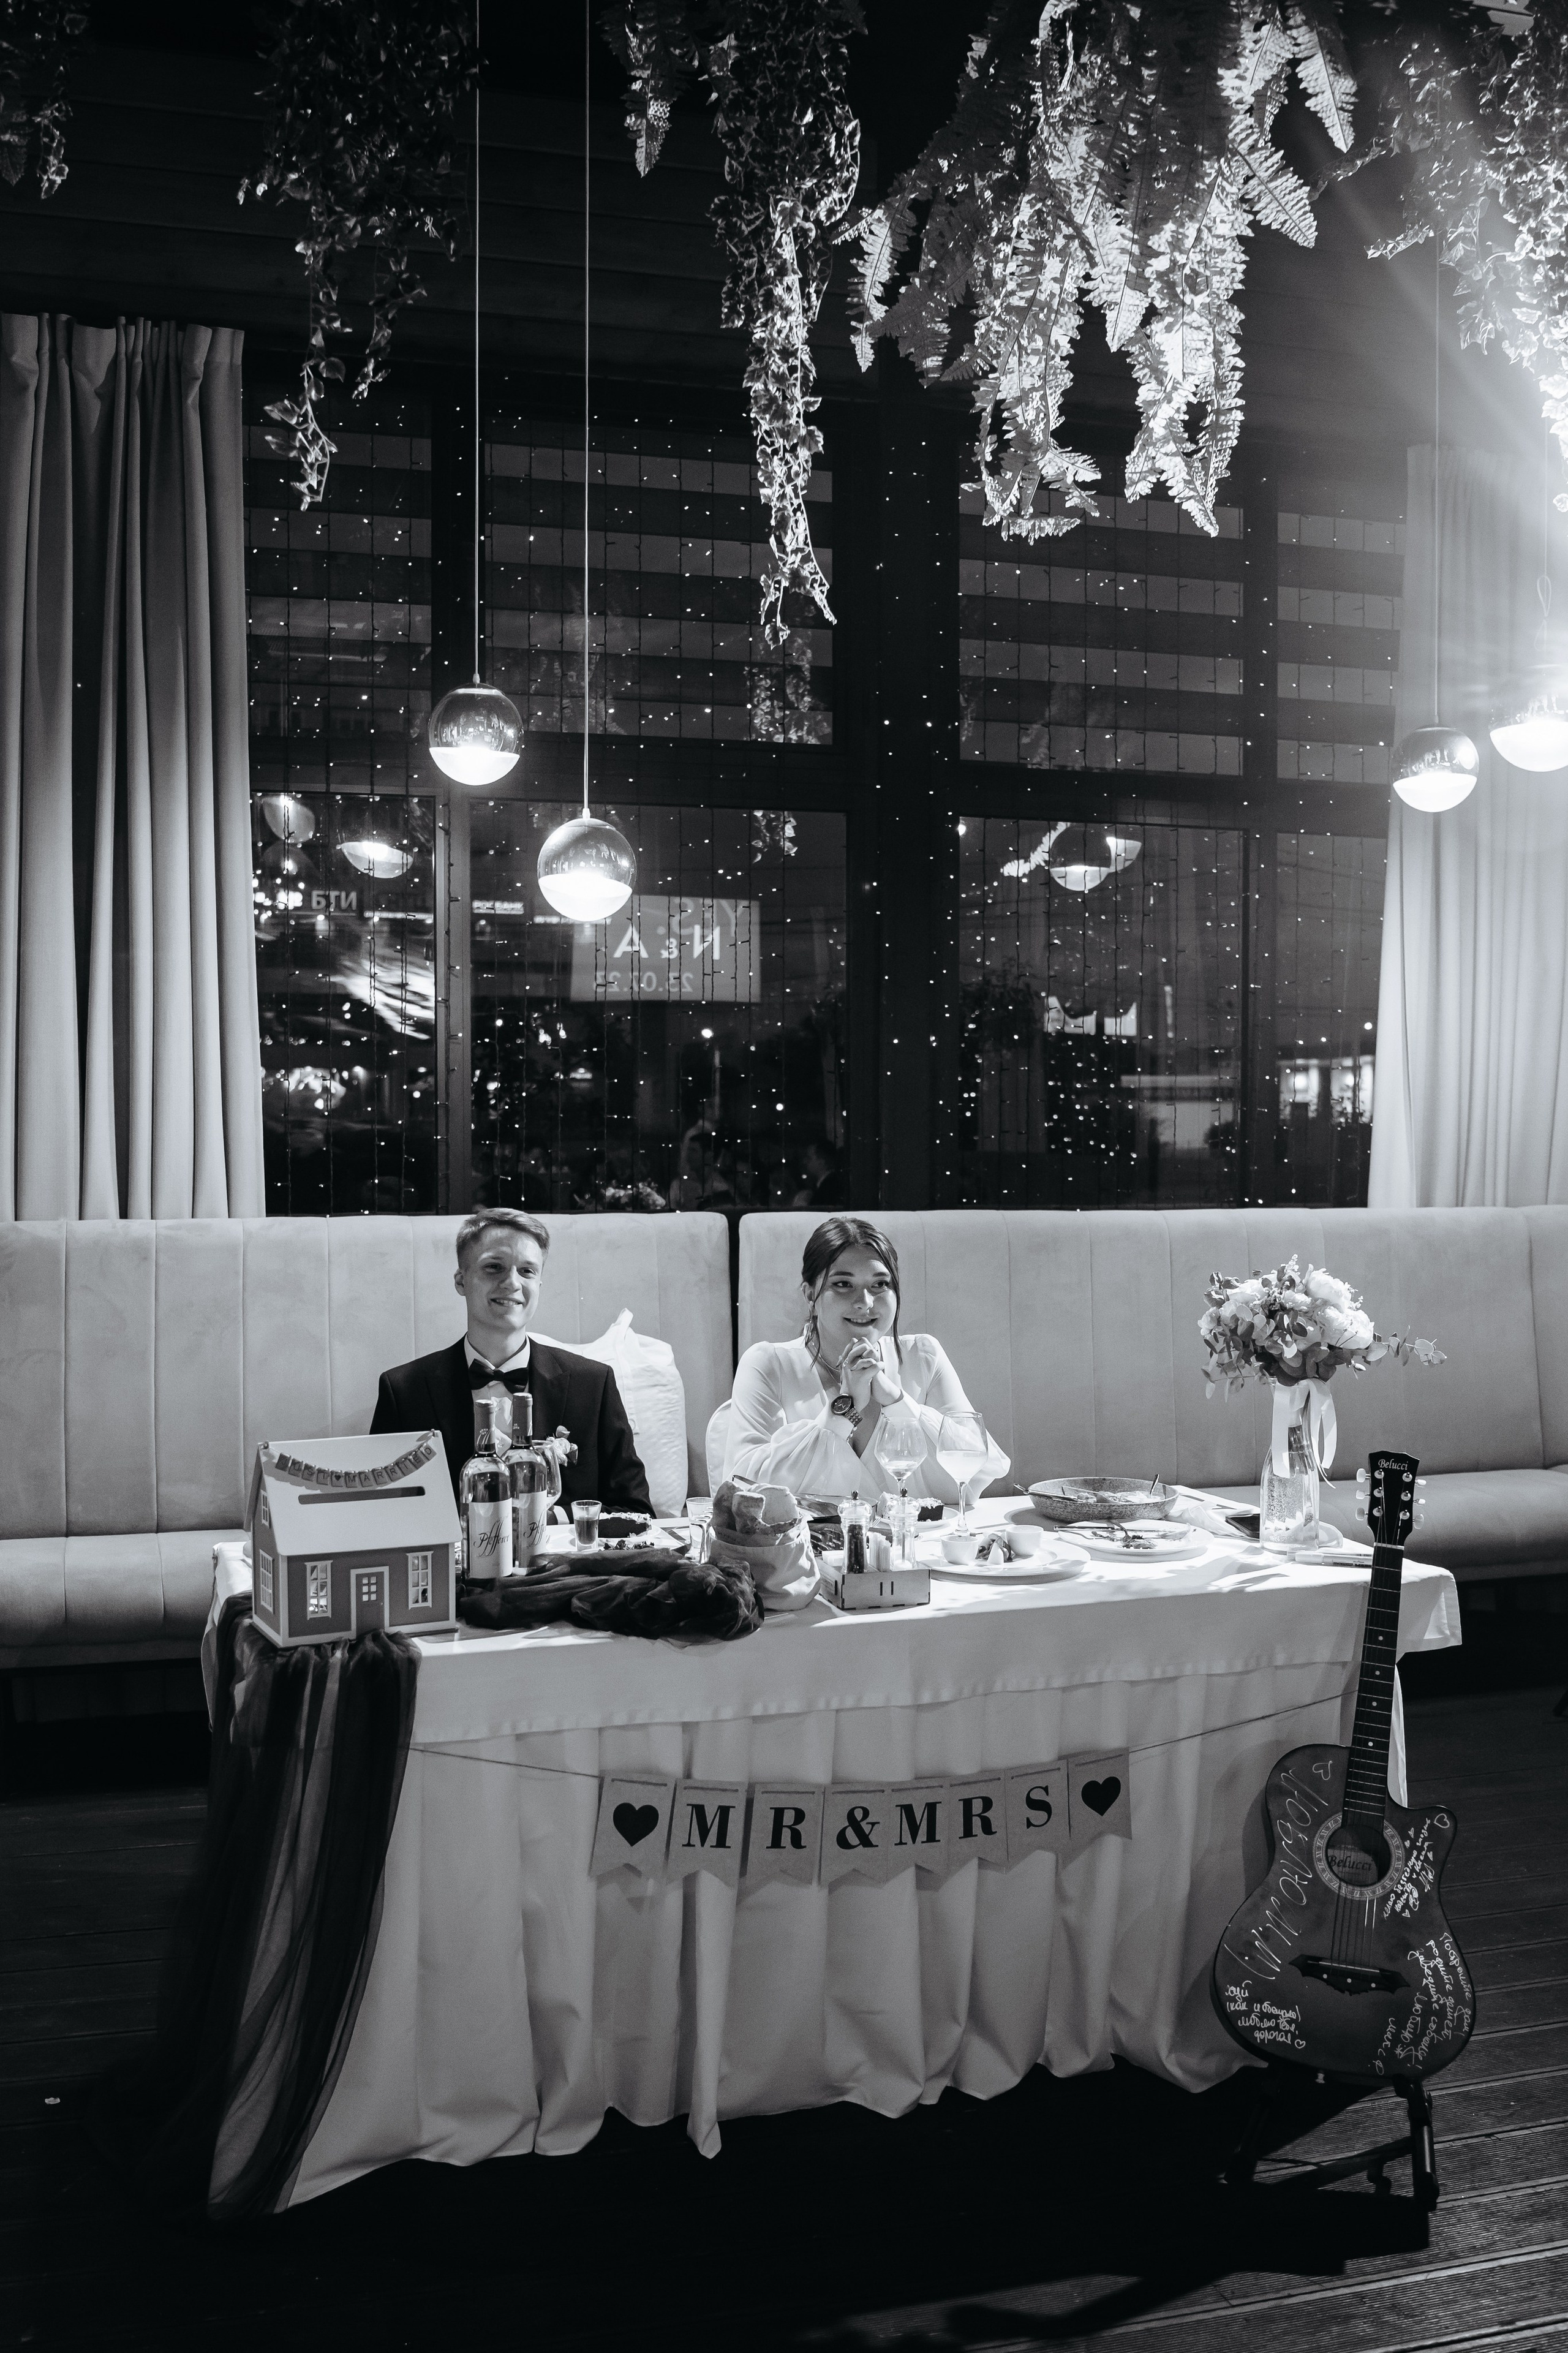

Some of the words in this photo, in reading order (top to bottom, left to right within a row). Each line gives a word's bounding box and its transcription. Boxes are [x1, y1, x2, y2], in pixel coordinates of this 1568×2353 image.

[280, 1457, 327, 1479] JUST
[347, 1446, 434, 1483] MARRIED
[1378, 1458, 1409, 1471] Belucci
[473, 1516, 510, 1558] Pfefferer
[1277, 1767, 1329, 1905] ЛЮБЛЮ
[1328, 1854, 1373, 1871] Belucci
